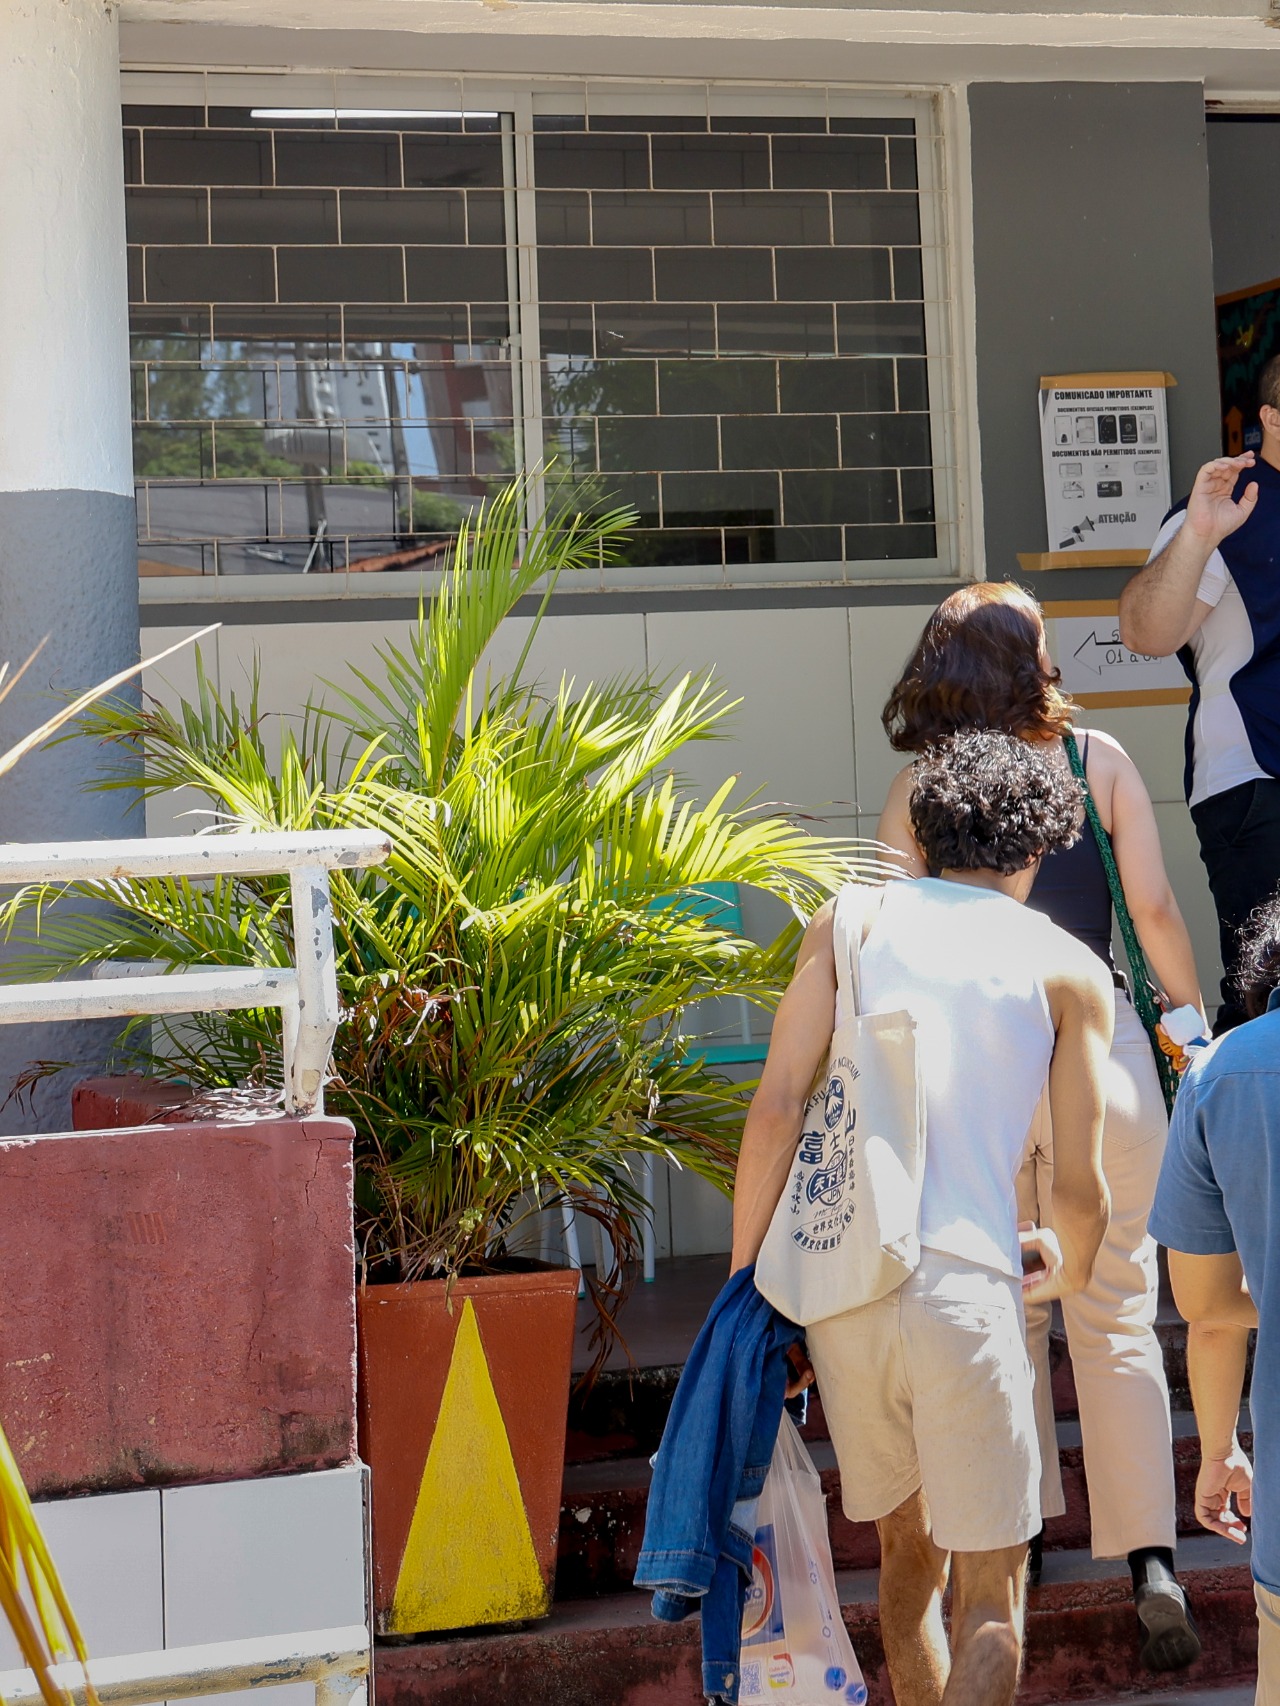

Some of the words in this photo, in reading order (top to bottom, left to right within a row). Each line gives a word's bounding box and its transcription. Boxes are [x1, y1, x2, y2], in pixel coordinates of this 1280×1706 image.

[1054, 390, 1105, 400] COMUNICADO
[1106, 390, 1153, 399] IMPORTANTE
[1052, 449, 1090, 458] DOCUMENTOS
[1090, 449, 1102, 457] NÃO
[1102, 448, 1137, 456] PERMITIDOS
[1098, 511, 1137, 524] ATENÇÃO
[1105, 649, 1123, 664] 01
